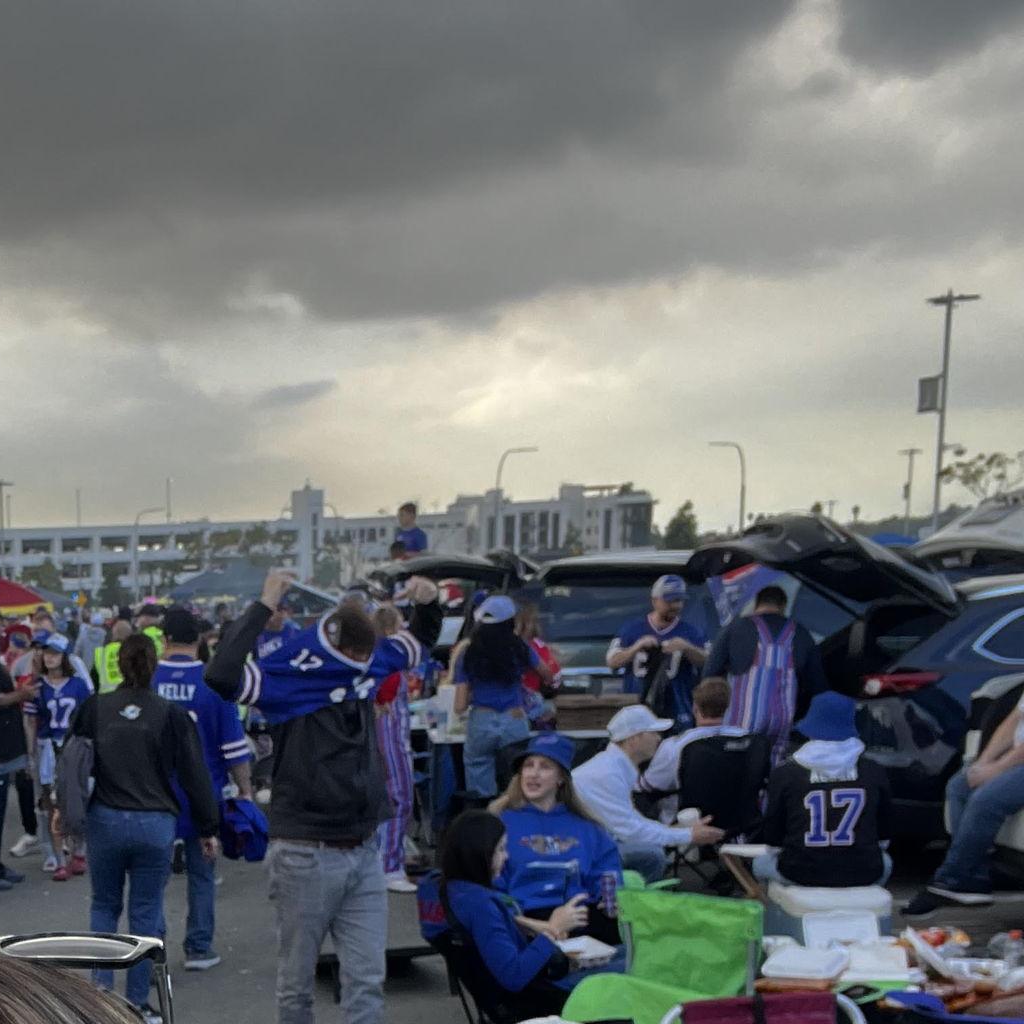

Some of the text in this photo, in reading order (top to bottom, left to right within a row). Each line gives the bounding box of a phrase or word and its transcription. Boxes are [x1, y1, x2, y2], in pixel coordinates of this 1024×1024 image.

[157, 682, 197, 702] KELLY
[46, 697, 77, 729] 17
[803, 788, 867, 847] 17
